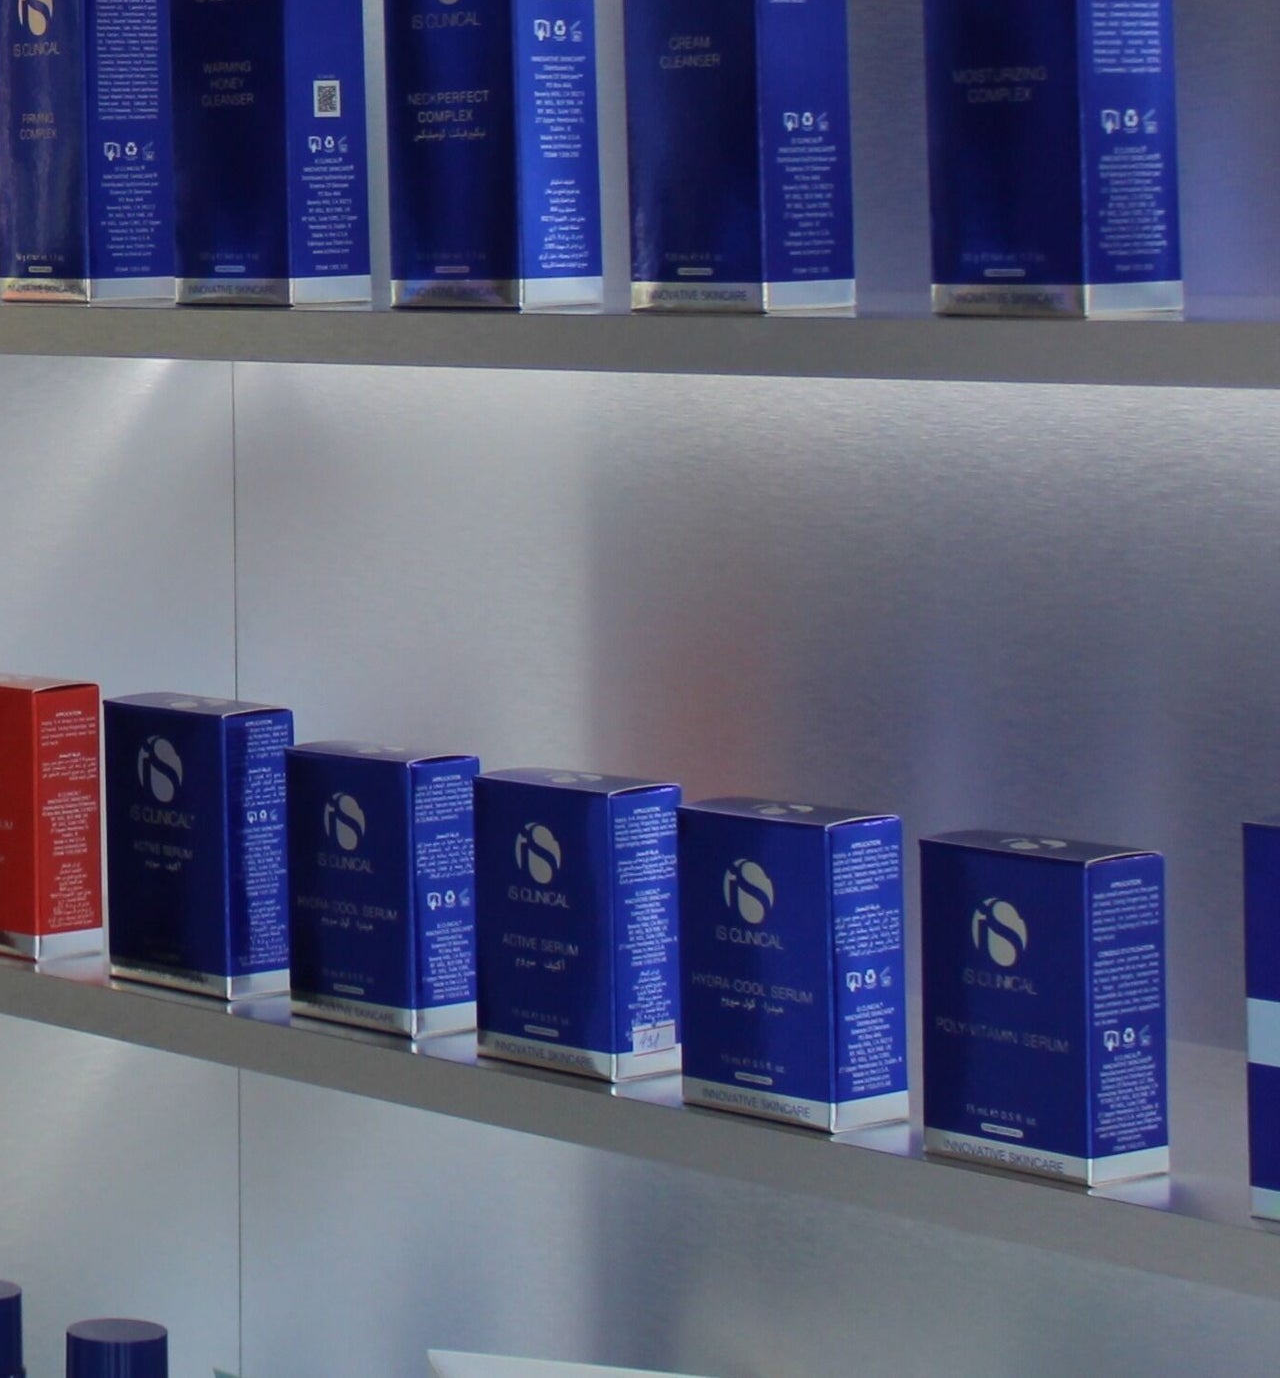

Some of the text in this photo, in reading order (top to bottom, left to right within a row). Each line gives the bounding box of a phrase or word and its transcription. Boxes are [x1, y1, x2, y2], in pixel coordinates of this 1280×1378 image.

[426, 12, 481, 29] CLINICAL
[25, 42, 60, 56] CLINICAL
[668, 36, 711, 50] CREAM
[203, 60, 252, 74] WARMING
[659, 54, 721, 70] CLEANSER
[209, 78, 245, 89] HONEY
[952, 66, 1047, 84] MOISTURIZING
[201, 93, 254, 107] CLEANSER
[408, 89, 490, 106] NECKPERFECT
[967, 87, 1033, 104] COMPLEX
[22, 112, 54, 124] FIRMING
[417, 109, 473, 124] COMPLEX
[19, 128, 57, 140] COMPLEX
[188, 285, 275, 295] INNOVATIVE SKINCARE
[700, 288, 748, 302] SKINCARE
[519, 888, 571, 909] CLINICAL
[502, 932, 579, 956] ACTIVE SERUM
[729, 927, 784, 950] CLINICAL
[770, 985, 814, 1004] SERUM
[495, 1039, 544, 1059] INNOVATIVE
[1022, 1033, 1070, 1054] SERUM
[702, 1088, 811, 1119] INNOVATIVE SKINCARE
[944, 1139, 1065, 1173] INNOVATIVE SKINCARE
